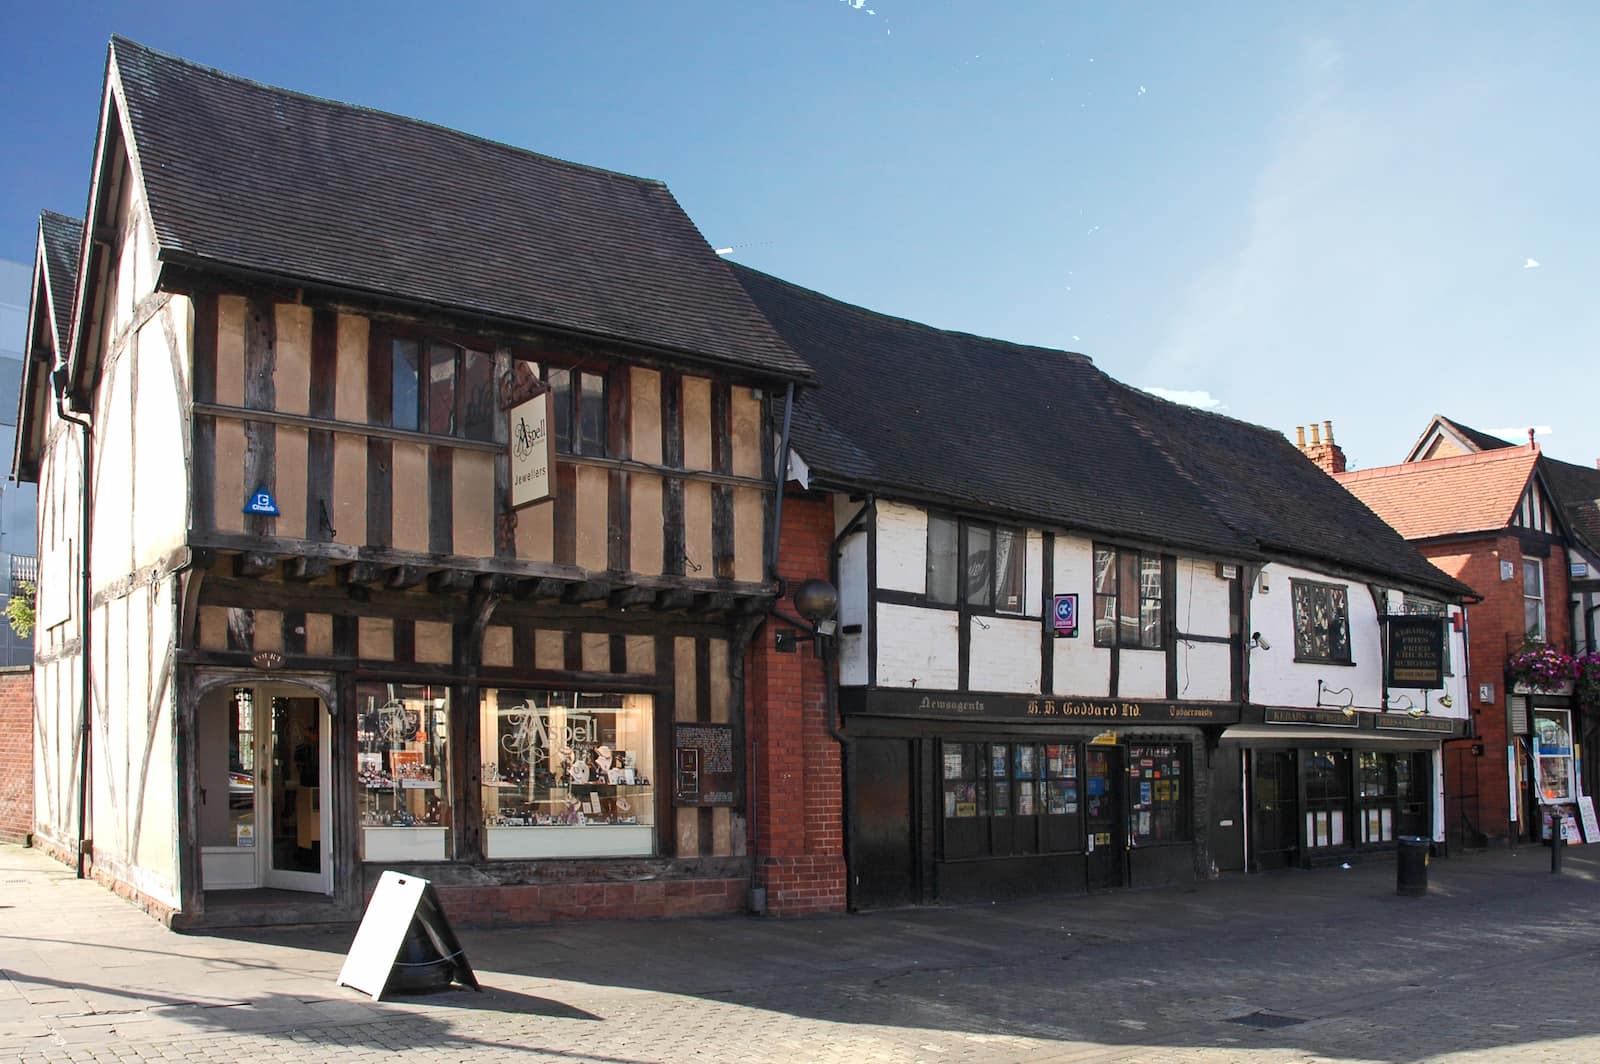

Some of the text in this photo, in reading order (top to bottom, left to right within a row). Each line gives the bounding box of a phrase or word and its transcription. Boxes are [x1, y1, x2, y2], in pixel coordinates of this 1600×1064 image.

[514, 417, 545, 456] Aspell
[514, 466, 546, 486] Jewellers
[919, 697, 985, 713] Newsagents
[1063, 702, 1117, 717] Goddard
[502, 699, 598, 757] Aspell
